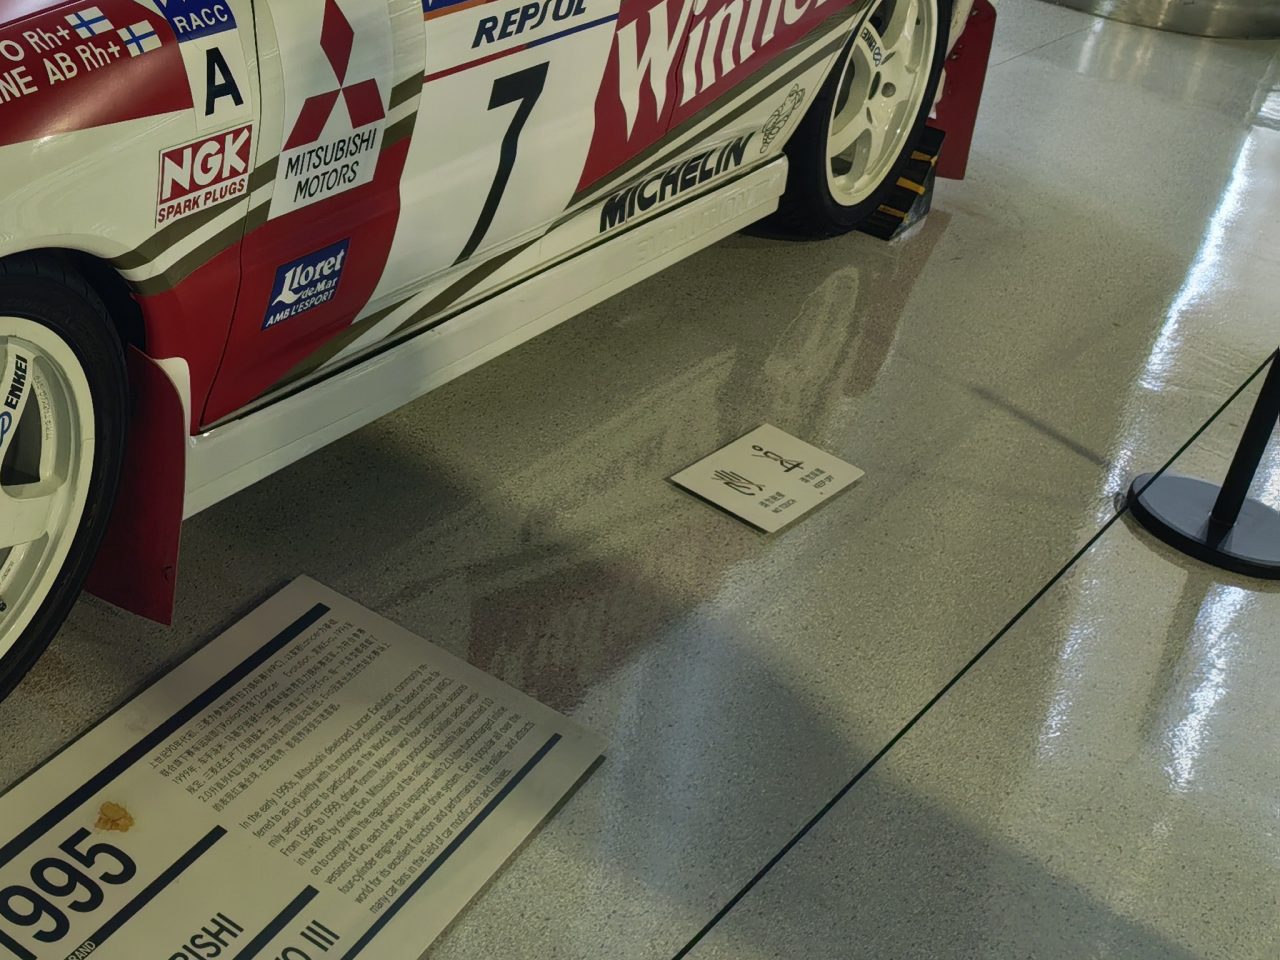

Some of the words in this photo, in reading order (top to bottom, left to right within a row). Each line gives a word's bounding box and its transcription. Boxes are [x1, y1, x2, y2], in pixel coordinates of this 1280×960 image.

[0, 38, 25, 62] O
[22, 24, 70, 55] Rh+
[176, 4, 228, 34] RACC
[45, 52, 78, 86] AB
[79, 40, 121, 72] Rh+
[205, 47, 244, 116] A
[162, 128, 250, 202] NGK
[285, 128, 376, 180] MITSUBISHI
[453, 61, 549, 266] 7
[157, 197, 201, 223] SPARK
[203, 179, 246, 206] PLUGS
[294, 161, 359, 203] MOTORS
[600, 131, 756, 233] MICHELIN
[271, 249, 345, 306] Lloret
[265, 308, 290, 327] AMB
[291, 289, 334, 315] L'ESPORT
[5, 354, 28, 410] ENKEI
[246, 811, 261, 822] the
[259, 799, 278, 812] early
[273, 781, 300, 798] 1990s,
[252, 819, 274, 838] ferred
[279, 808, 289, 816] as
[285, 798, 300, 808] Evo
[299, 783, 319, 800] jointly
[268, 834, 286, 847] mily
[283, 817, 302, 834] sedan
[298, 799, 322, 817] Lancer
[280, 841, 300, 856] From
[296, 823, 318, 841] 1996
[321, 801, 345, 818] 1999,
[301, 848, 316, 859] the
[311, 832, 331, 849] WRC
[327, 826, 341, 834] by
[334, 808, 361, 827] driving
[311, 866, 321, 874] on
[326, 839, 351, 860] comply
[346, 825, 361, 840] with
[356, 818, 371, 828] the
[352, 843, 372, 855] Evo,
[367, 827, 383, 843] each
[325, 860, 351, 884] versions
[338, 858, 377, 894] four-cylinder
[375, 839, 396, 859] engine
[348, 852, 358, 861] of
[355, 884, 374, 904] world
[369, 877, 382, 887] for
[378, 869, 391, 878] its
[388, 842, 415, 870] excellent
[369, 895, 390, 913] many
[385, 885, 398, 896] car
[392, 872, 410, 886] fans
[405, 865, 417, 873] in
[411, 856, 426, 867] the
